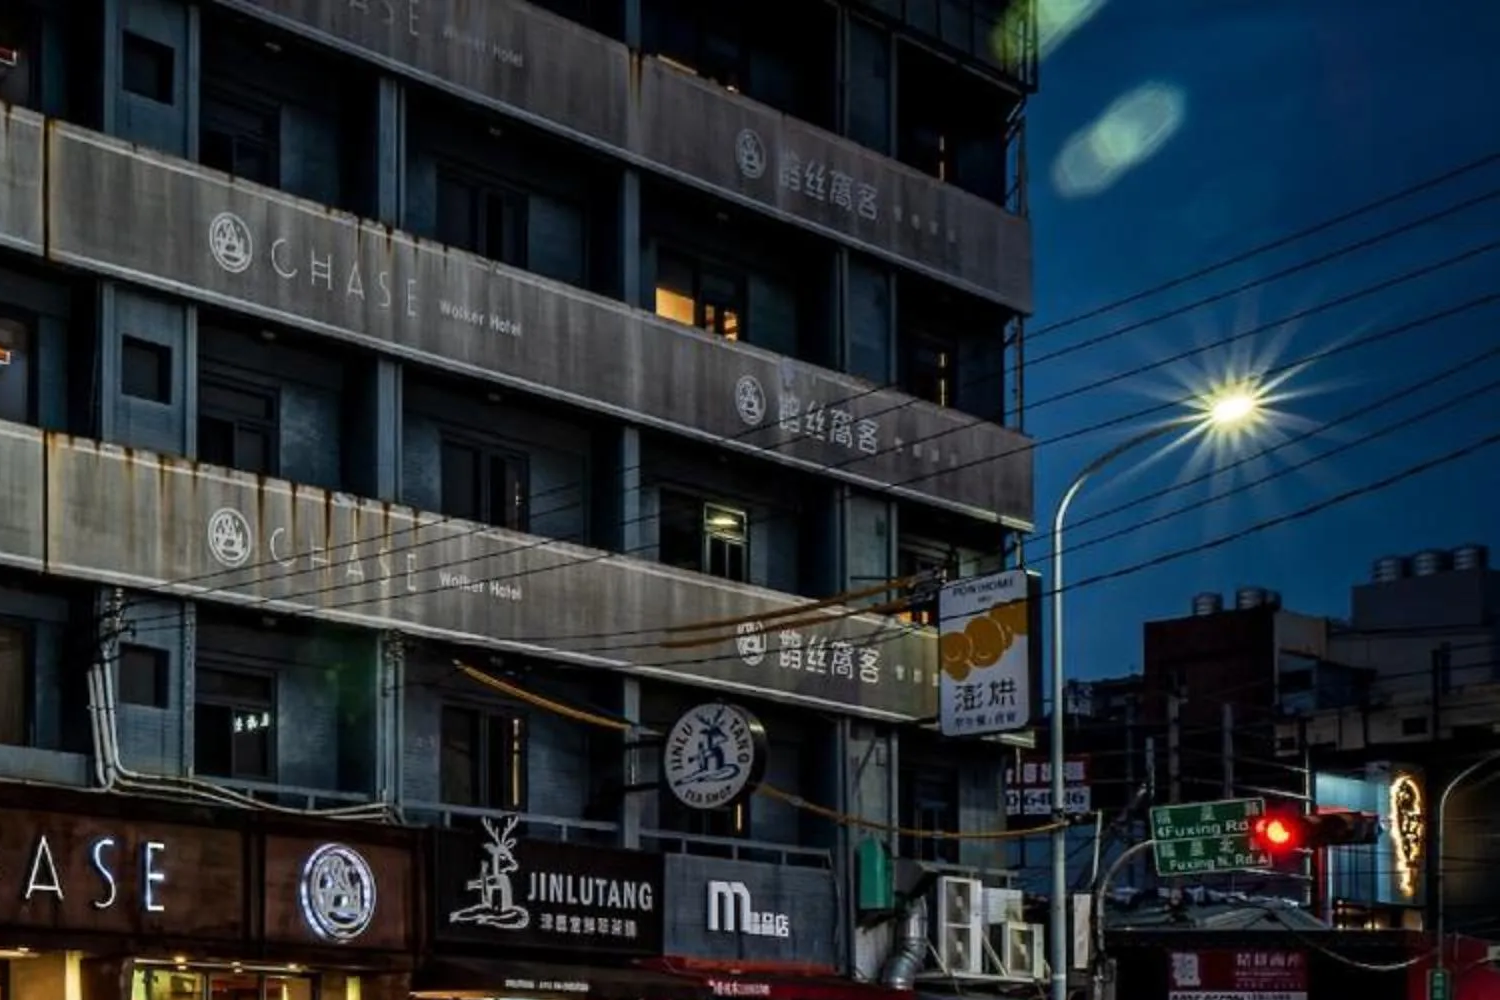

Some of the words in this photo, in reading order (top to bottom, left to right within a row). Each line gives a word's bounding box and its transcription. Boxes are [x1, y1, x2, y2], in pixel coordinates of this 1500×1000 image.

[270, 237, 418, 318] CHASE
[439, 299, 485, 326] Walker
[490, 310, 523, 338] Hotel
[269, 526, 417, 592] CHASE
[439, 571, 485, 594] Walker
[490, 581, 523, 602] Hotel
[671, 721, 694, 772] JINLU
[729, 717, 751, 764] TANG
[1164, 822, 1222, 838] Fuxing
[1169, 858, 1215, 872] Fuxing
[527, 871, 654, 912] JINLUTANG
